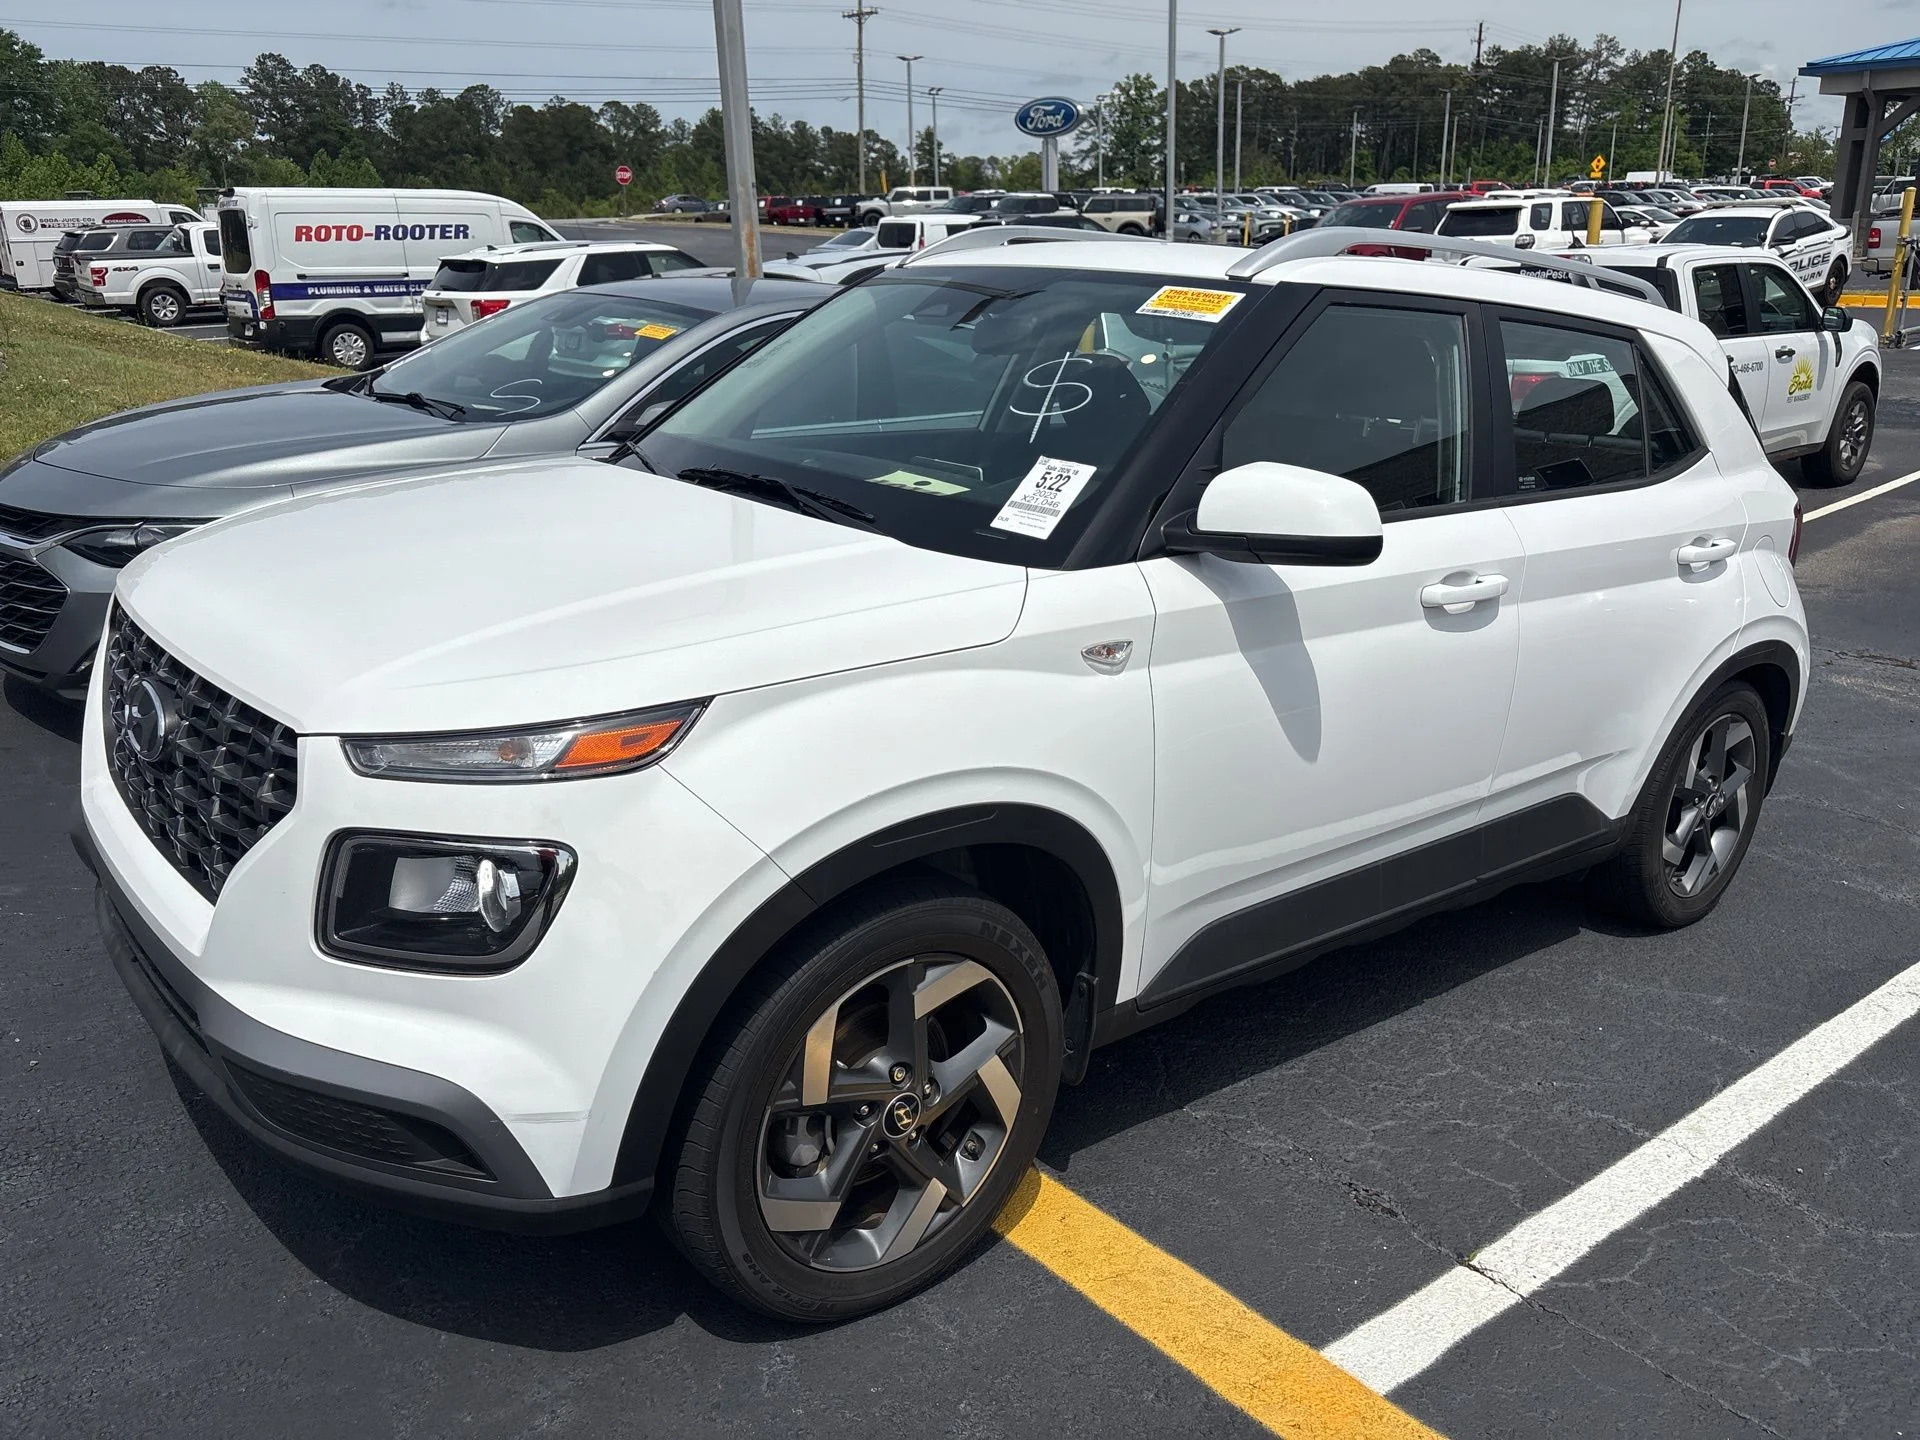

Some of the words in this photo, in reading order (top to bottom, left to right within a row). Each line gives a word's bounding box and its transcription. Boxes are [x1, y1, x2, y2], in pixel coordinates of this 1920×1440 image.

[1026, 104, 1066, 130] Ford
[617, 171, 631, 179] STOP
[295, 224, 469, 242] ROTO-ROOTER
[1789, 252, 1831, 271] OLICE
[1800, 270, 1823, 282] URN
[307, 285, 360, 295] PLUMBING
[363, 285, 372, 294] &
[374, 284, 406, 293] WATER
[1191, 290, 1231, 300] VEHICLE
[1201, 297, 1223, 305] SALE
[1566, 362, 1585, 376] ONLY
[1587, 359, 1603, 373] THE
[1731, 361, 1764, 375] 70-466-6700
[1045, 464, 1058, 472] Sale
[1036, 471, 1071, 493] 5:22
[1033, 489, 1058, 500] 2023
[978, 920, 1048, 990] NEXEN
